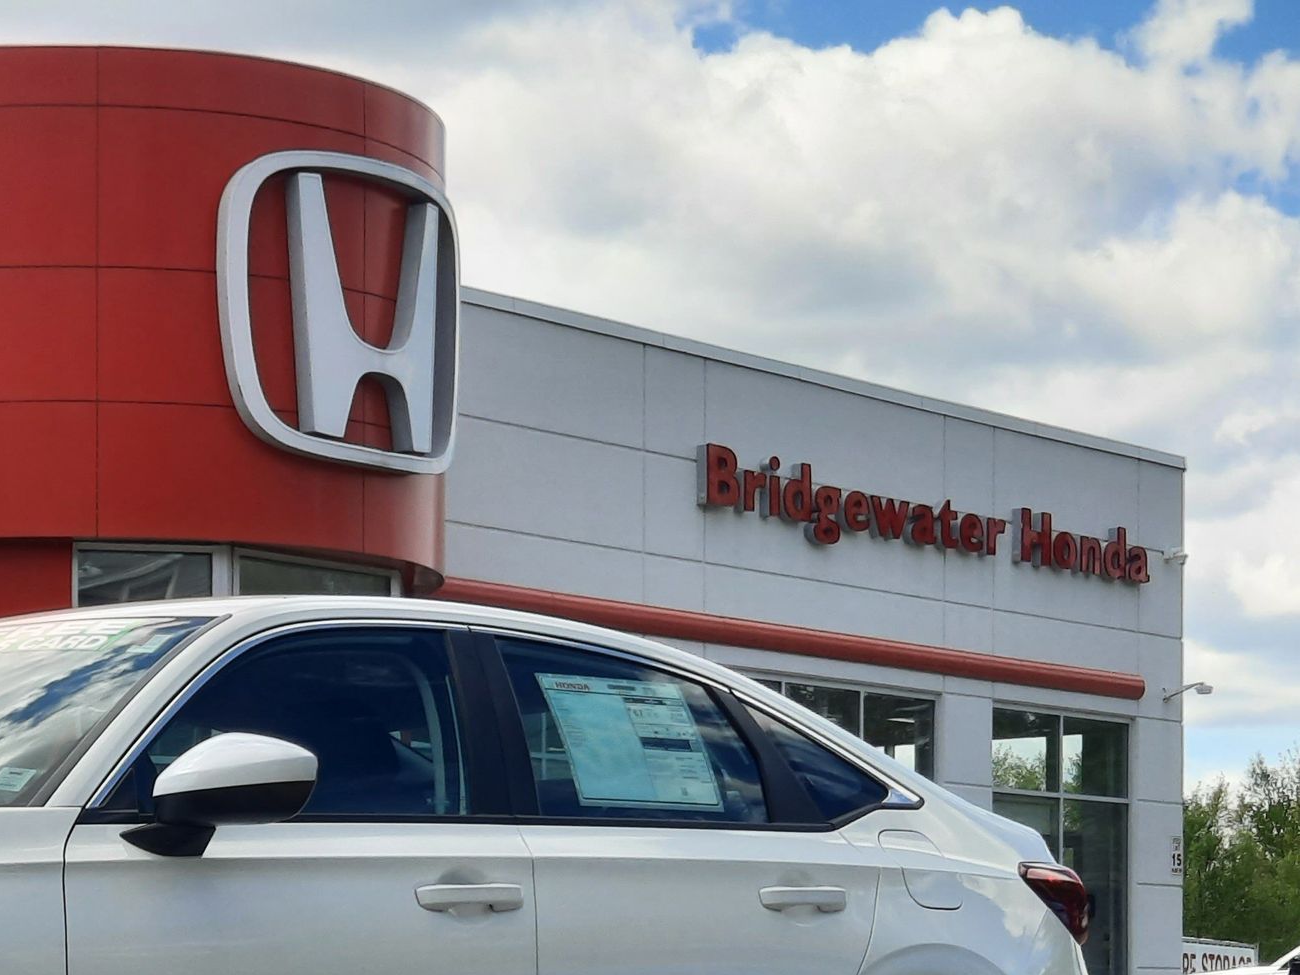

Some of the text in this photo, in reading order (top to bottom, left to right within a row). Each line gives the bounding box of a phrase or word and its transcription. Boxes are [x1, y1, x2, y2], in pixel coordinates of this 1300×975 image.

[701, 443, 1151, 584] Bridgewater Honda
[17, 635, 108, 651] CARD
[555, 681, 590, 691] HONDA
[1172, 854, 1182, 867] 15
